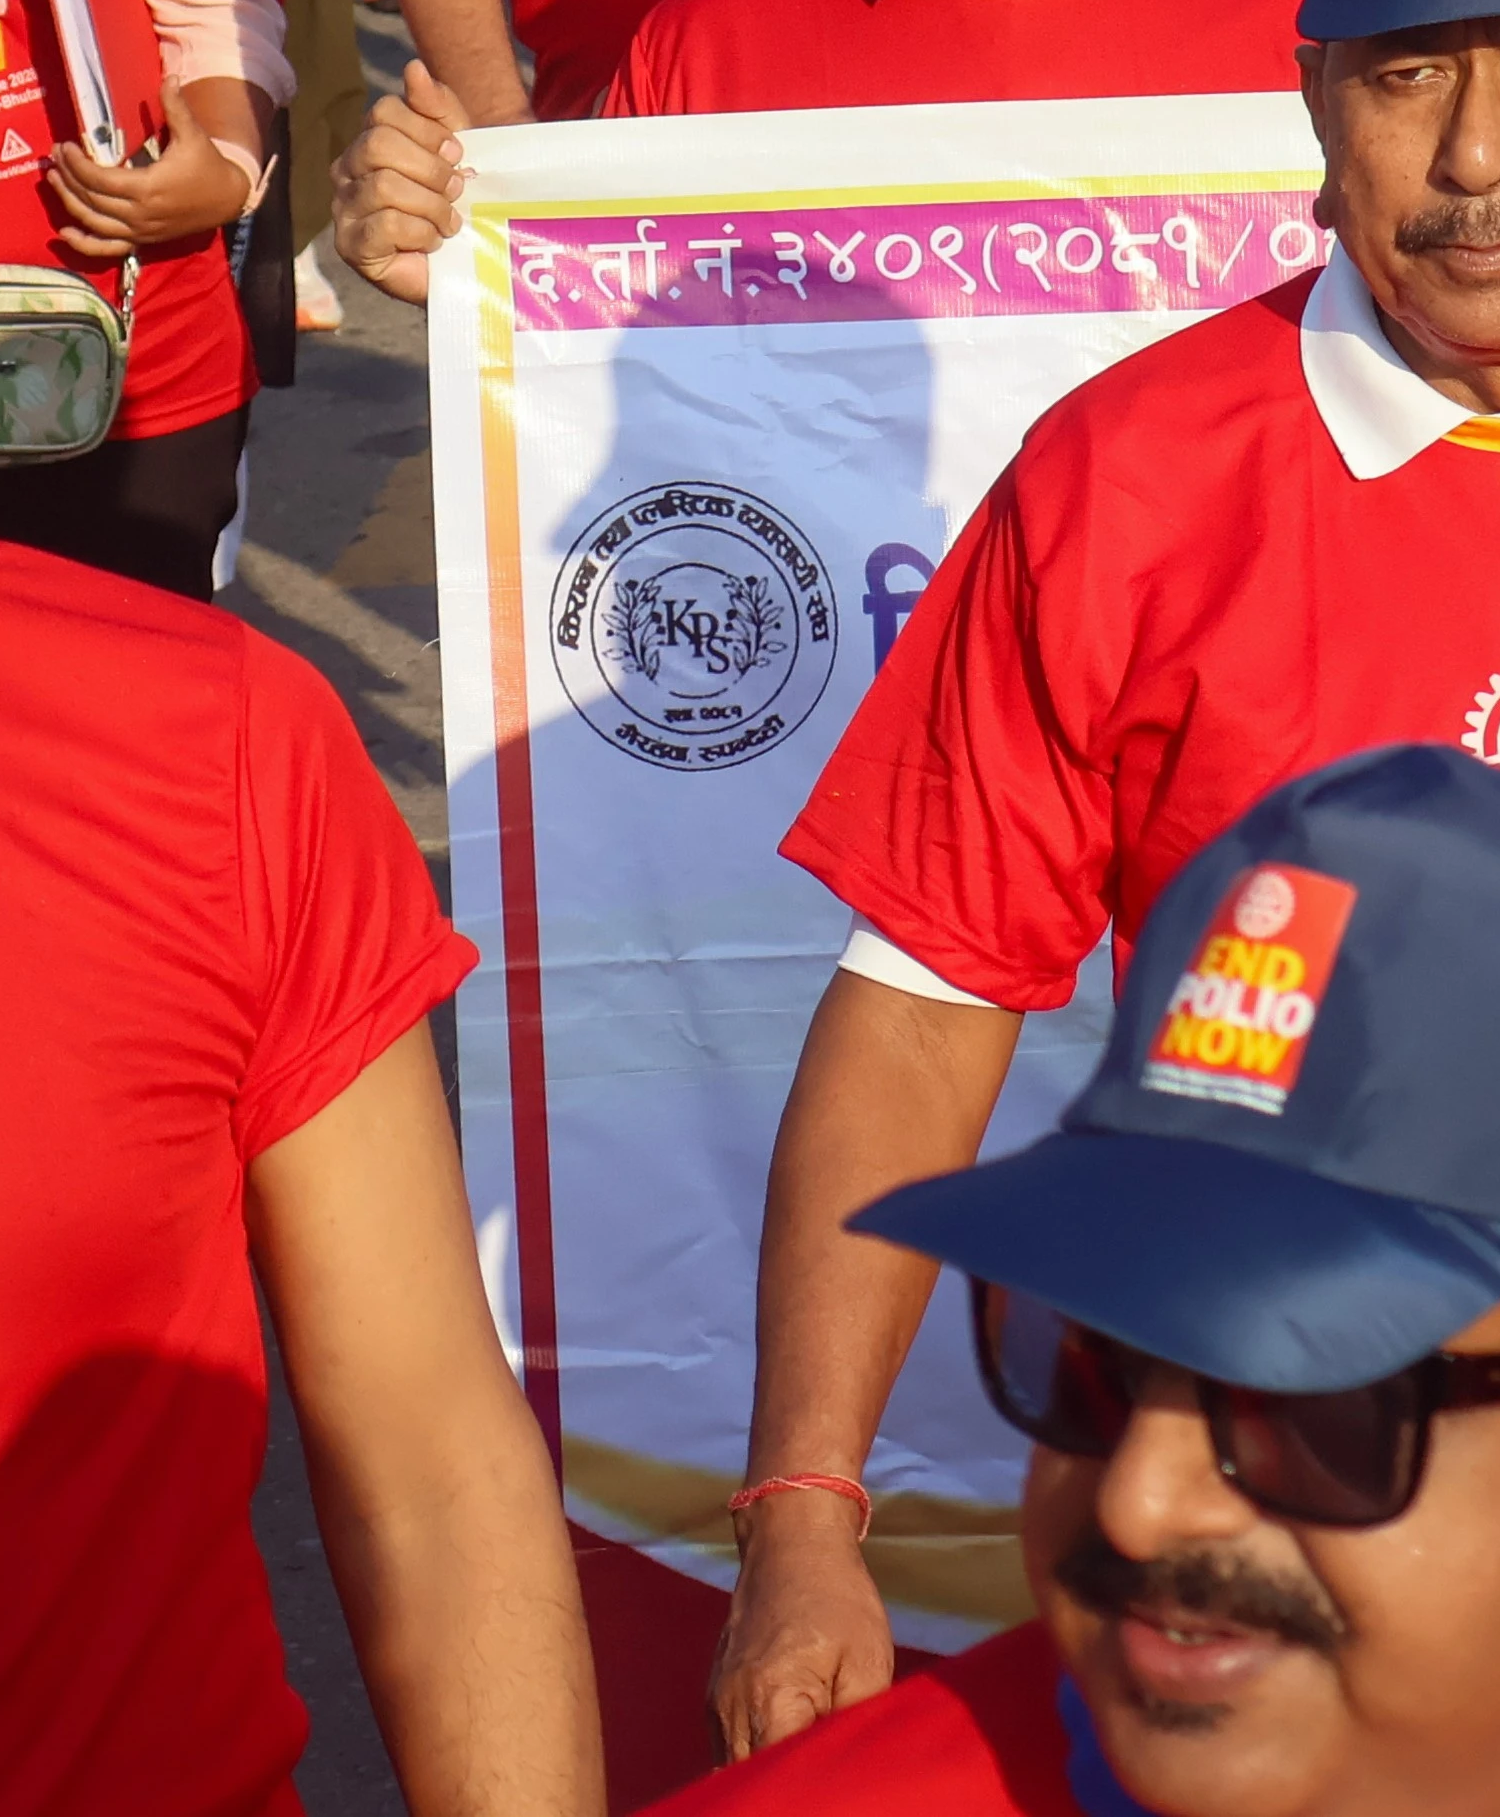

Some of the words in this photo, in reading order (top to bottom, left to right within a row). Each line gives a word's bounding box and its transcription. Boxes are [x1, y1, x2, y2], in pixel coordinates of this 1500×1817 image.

[663, 599, 730, 674] KPS
[1200, 937, 1306, 993] END
[1168, 973, 1316, 1038] POLIO
[1162, 1015, 1293, 1075] NOW
